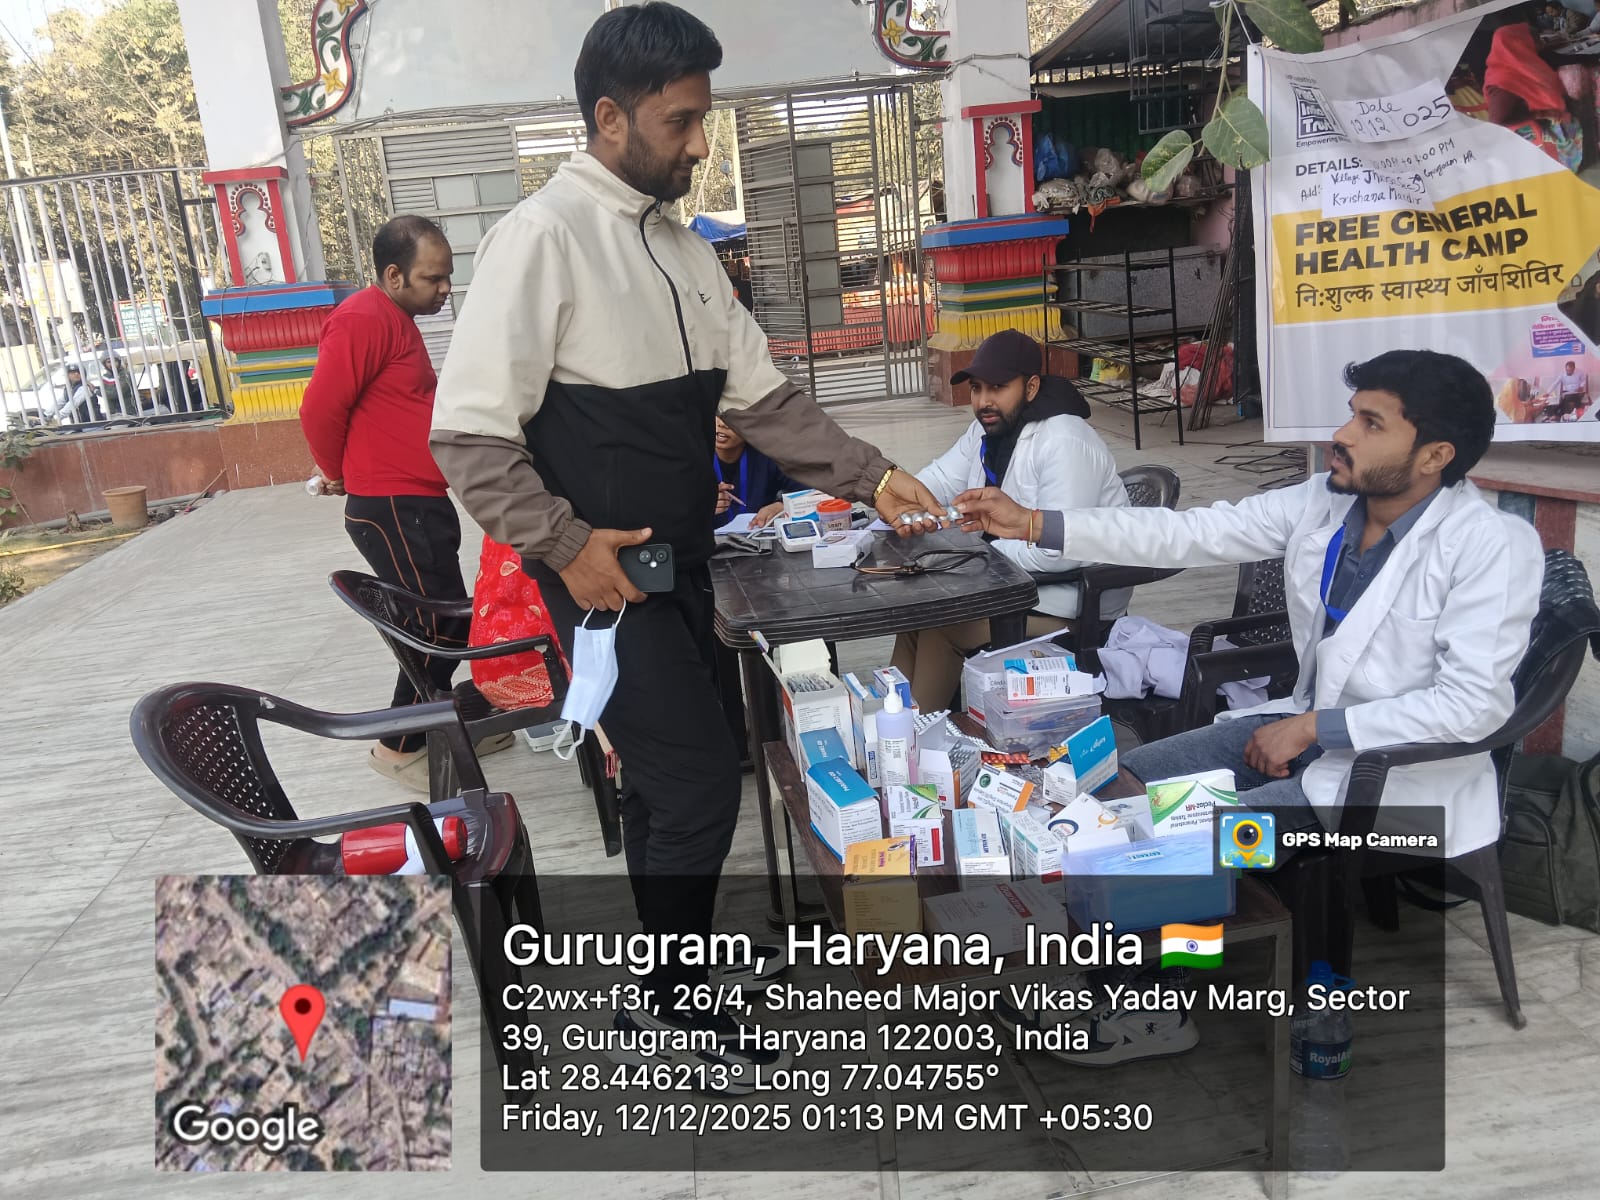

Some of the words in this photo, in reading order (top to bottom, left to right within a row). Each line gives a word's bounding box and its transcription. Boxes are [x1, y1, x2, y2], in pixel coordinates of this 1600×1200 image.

[1295, 157, 1363, 177] DETAILS:
[1295, 214, 1380, 247] FREE
[1390, 193, 1538, 236] GENERAL
[1295, 240, 1430, 276] HEALTH
[1441, 227, 1529, 262] CAMP
[1380, 277, 1451, 301] स्वास्थ्य
[1501, 260, 1565, 294] शिविर
